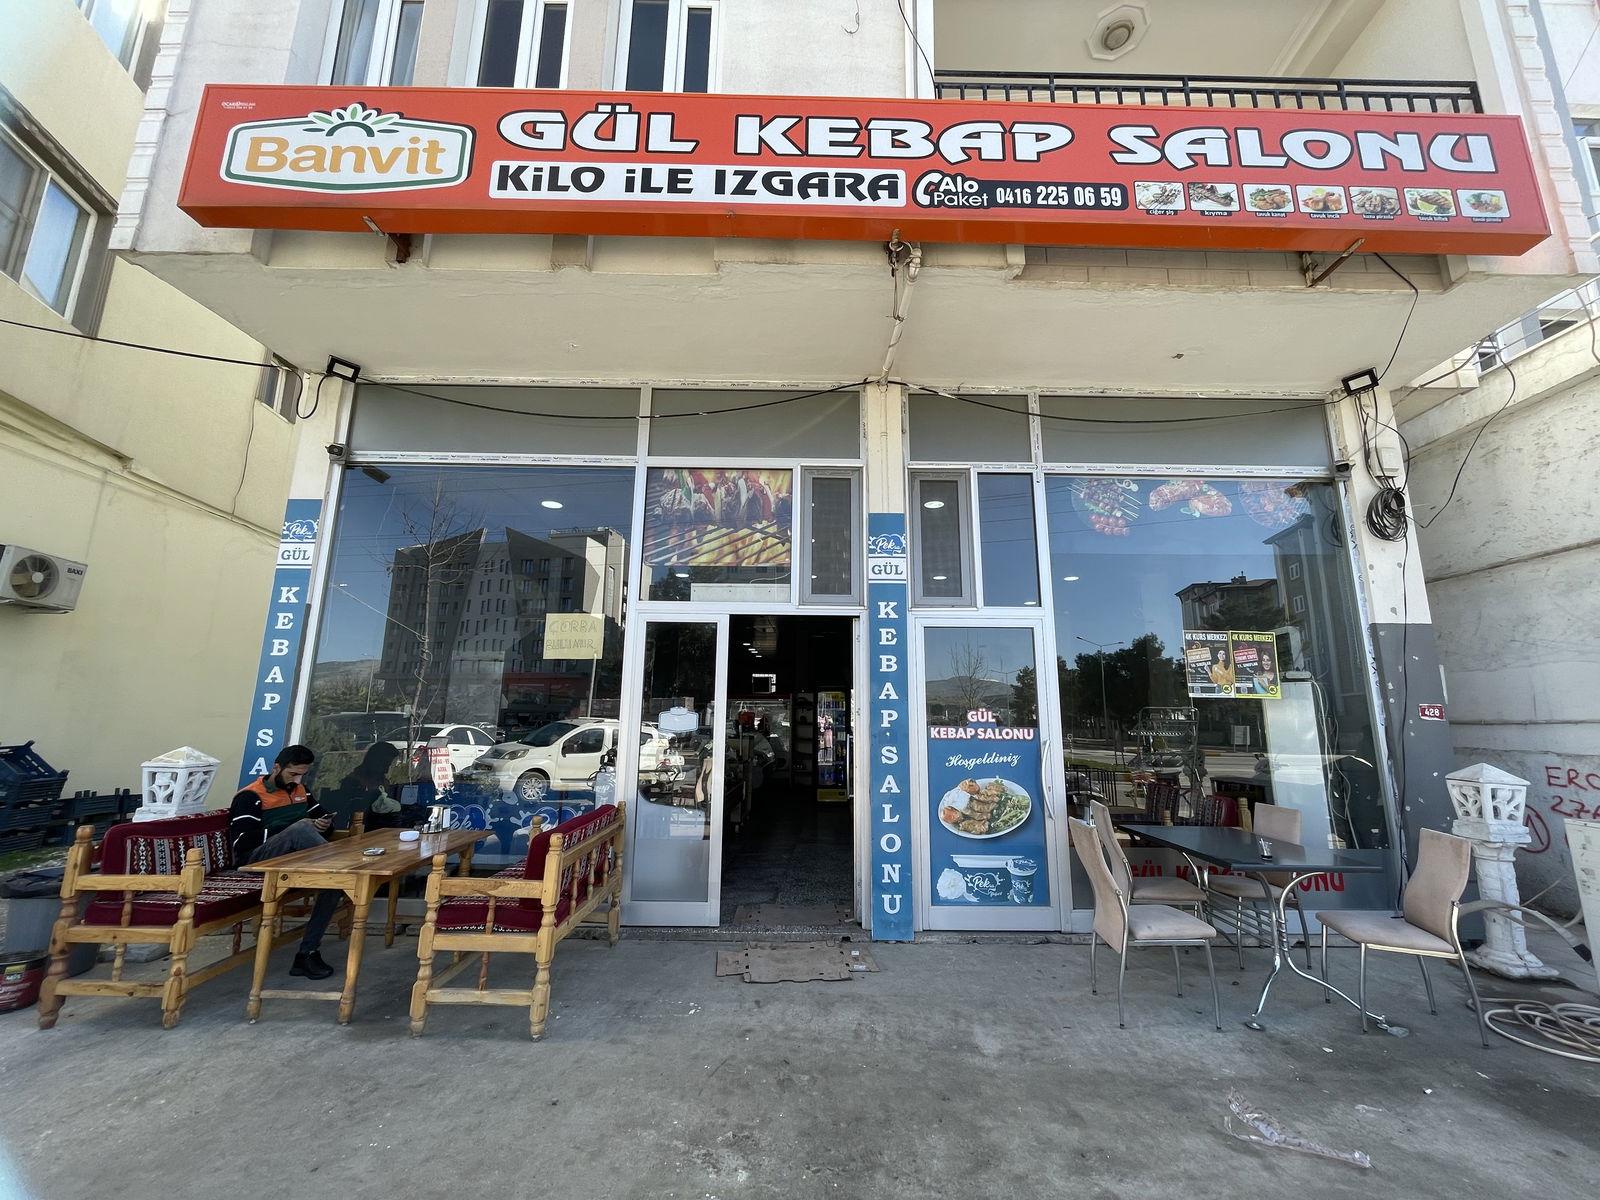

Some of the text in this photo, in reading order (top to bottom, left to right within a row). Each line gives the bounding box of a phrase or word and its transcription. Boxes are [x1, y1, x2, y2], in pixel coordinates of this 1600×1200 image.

[497, 103, 1500, 174] GÜL KEBAP SALONU
[244, 136, 447, 175] Banvit
[714, 169, 900, 202] IZGARA
[938, 175, 979, 193] Alo
[934, 191, 989, 207] Paket
[995, 185, 1123, 207] 0416 225 06 59
[281, 547, 311, 561] GÜL
[871, 562, 904, 576] GÜL
[262, 586, 300, 711] KEBAP
[967, 708, 996, 722] GÜL
[1424, 708, 1440, 717] 428
[930, 727, 1034, 740] KEBAP SALONU
[878, 601, 902, 915] KEBAP SALONU
[945, 752, 1022, 770] Hoşgeldiniz
